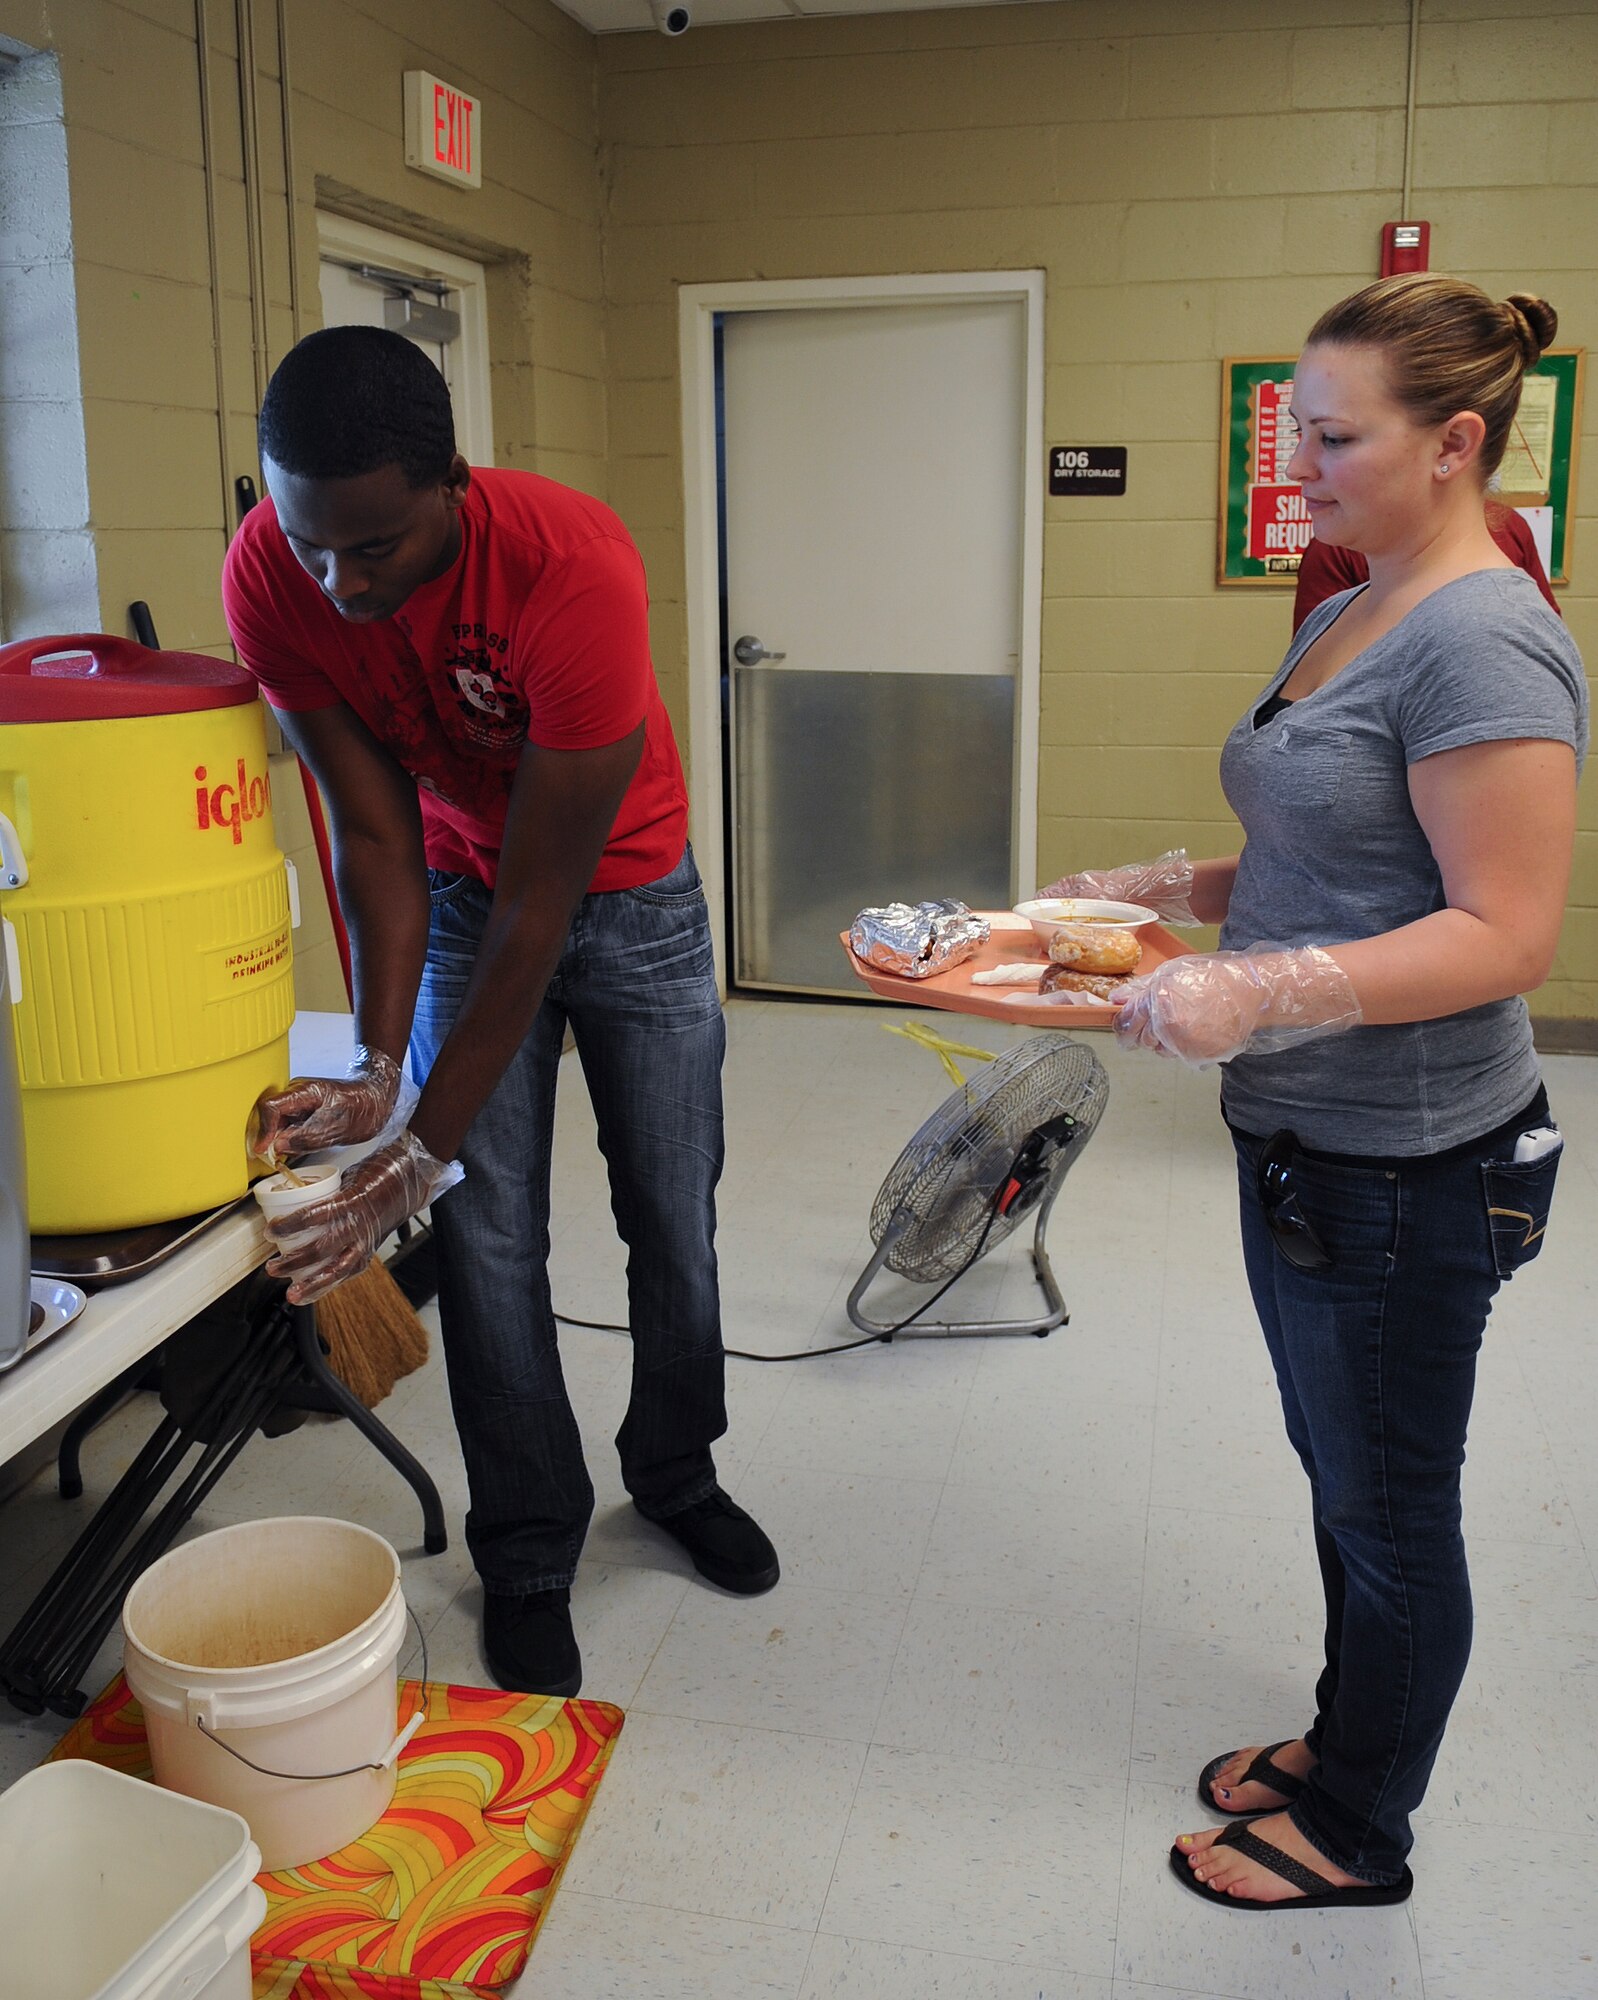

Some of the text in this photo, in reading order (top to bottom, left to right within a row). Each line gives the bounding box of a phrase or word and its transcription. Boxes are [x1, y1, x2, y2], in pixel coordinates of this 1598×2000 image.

[434, 83, 472, 173] EXIT
[1056, 451, 1090, 469] 106
[1053, 469, 1122, 478] DRY STORAGE
